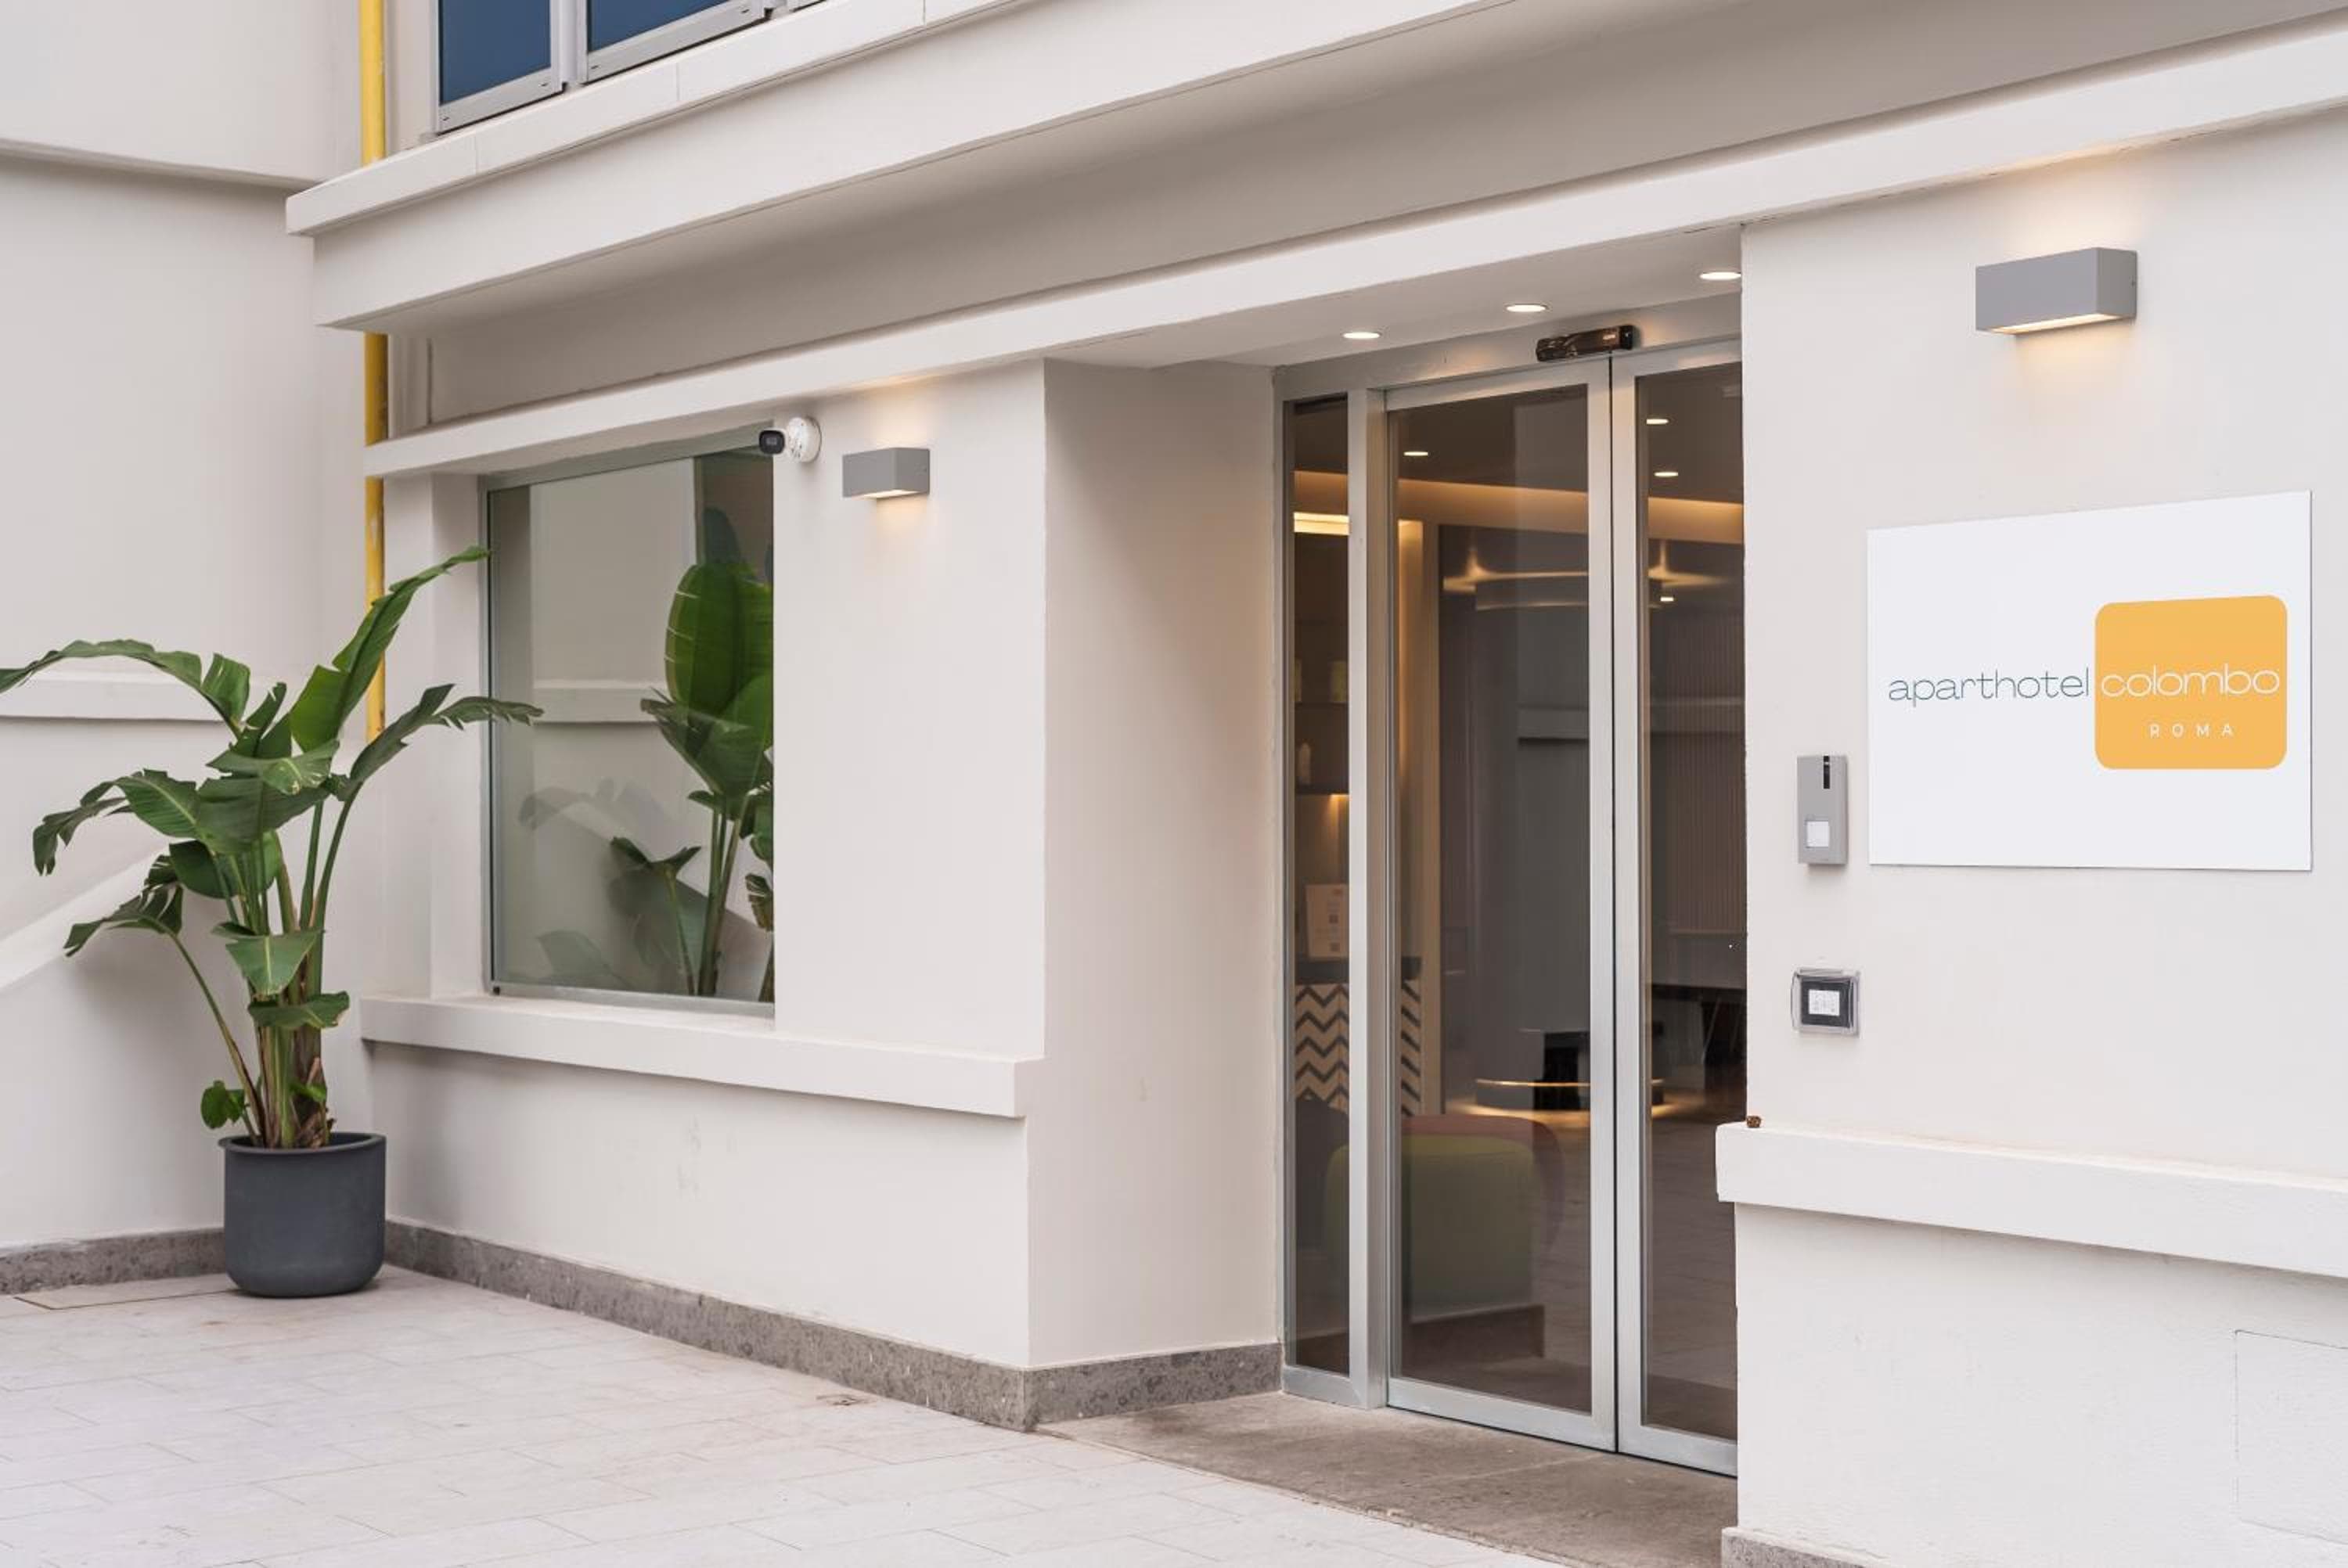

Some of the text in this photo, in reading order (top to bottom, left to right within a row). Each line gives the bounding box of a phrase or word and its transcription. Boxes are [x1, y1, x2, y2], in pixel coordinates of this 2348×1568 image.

[1888, 664, 2281, 707] aparthotel colombo
[2149, 722, 2235, 738] ROMA
